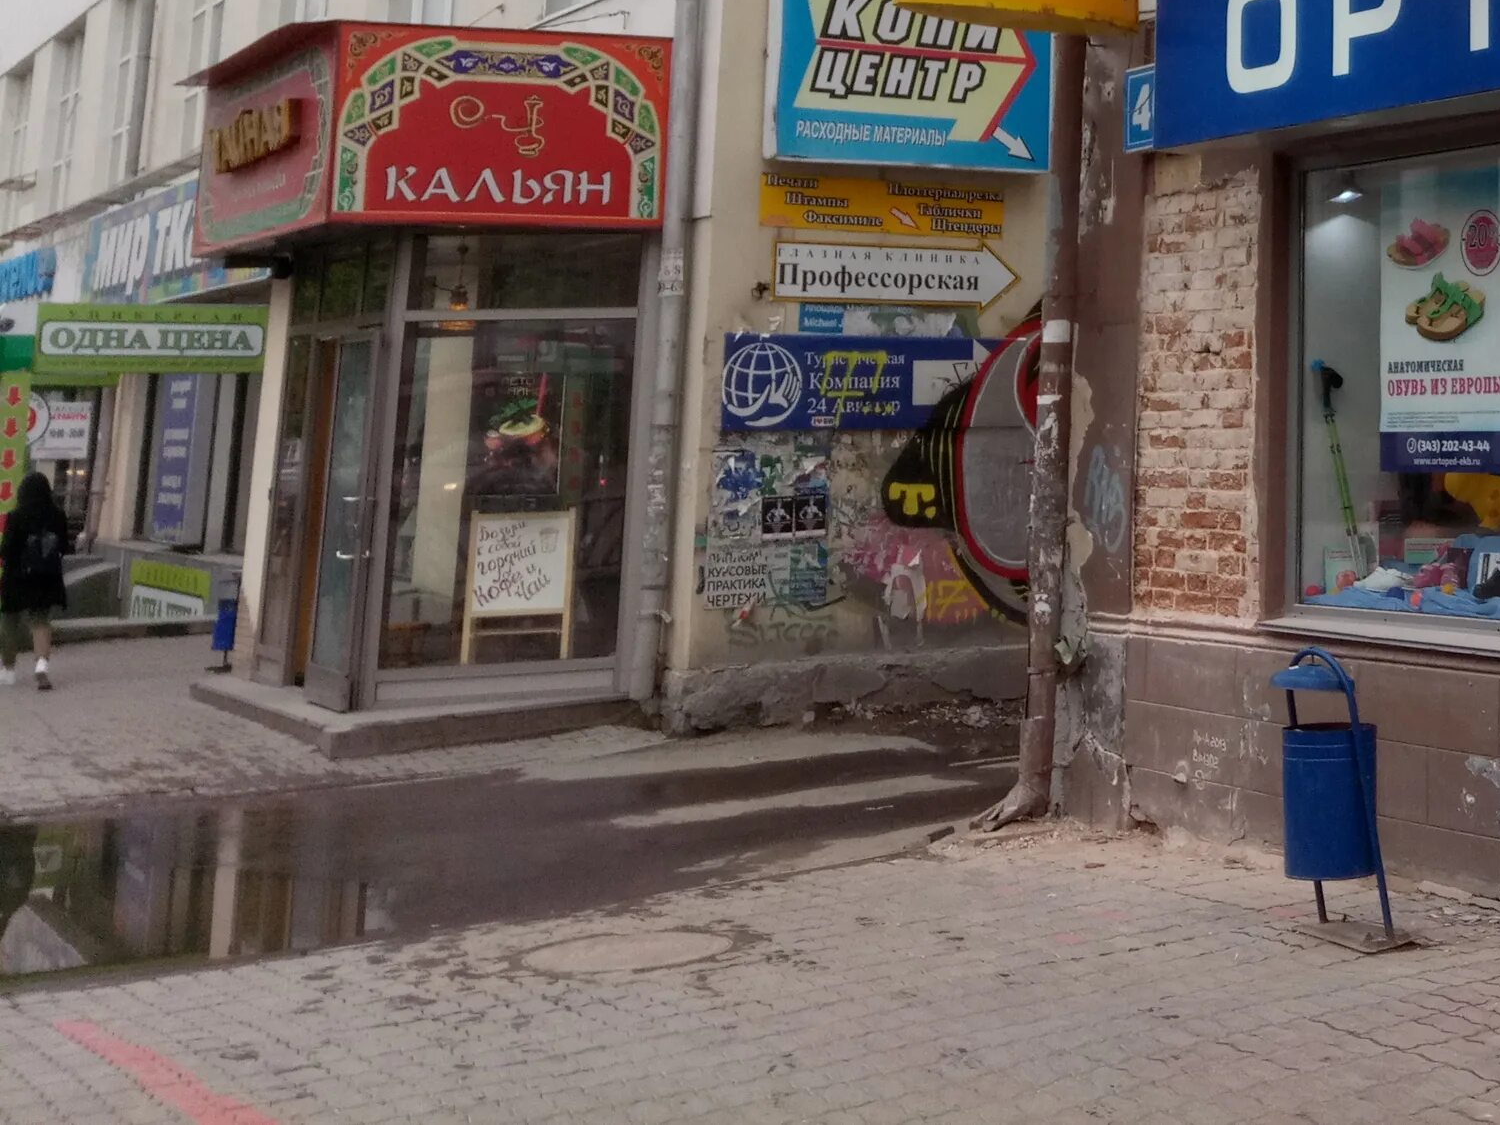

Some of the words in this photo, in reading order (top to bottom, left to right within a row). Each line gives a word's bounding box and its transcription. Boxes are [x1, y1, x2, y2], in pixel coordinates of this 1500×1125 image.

[809, 46, 987, 104] ЦЕНТР
[795, 120, 871, 144] РАСХОДНЫЕ
[873, 126, 947, 147] МАТЕРИАЛЫ
[385, 165, 612, 206] КАЛЬЯН
[766, 174, 818, 189] Печати
[785, 193, 848, 208] Штампы
[803, 211, 883, 227] Факсимиле
[919, 204, 982, 219] Таблички
[931, 218, 1001, 234] Штендеры
[778, 248, 871, 260] ГЛАЗНАЯ
[885, 252, 981, 265] КЛИНИКА
[778, 263, 979, 294] Профессорская
[50, 328, 152, 353] ОДНА
[157, 329, 254, 355] ЦЕНА
[1387, 359, 1464, 373] АНАТОМИЧЕСКАЯ
[1387, 379, 1427, 396] ОБУВЬ
[1431, 378, 1448, 395] ИЗ
[807, 397, 826, 414] 24
[1417, 439, 1440, 453] (343)
[1441, 439, 1490, 452] 202-43-44
[707, 578, 766, 591] ПРАКТИКА
